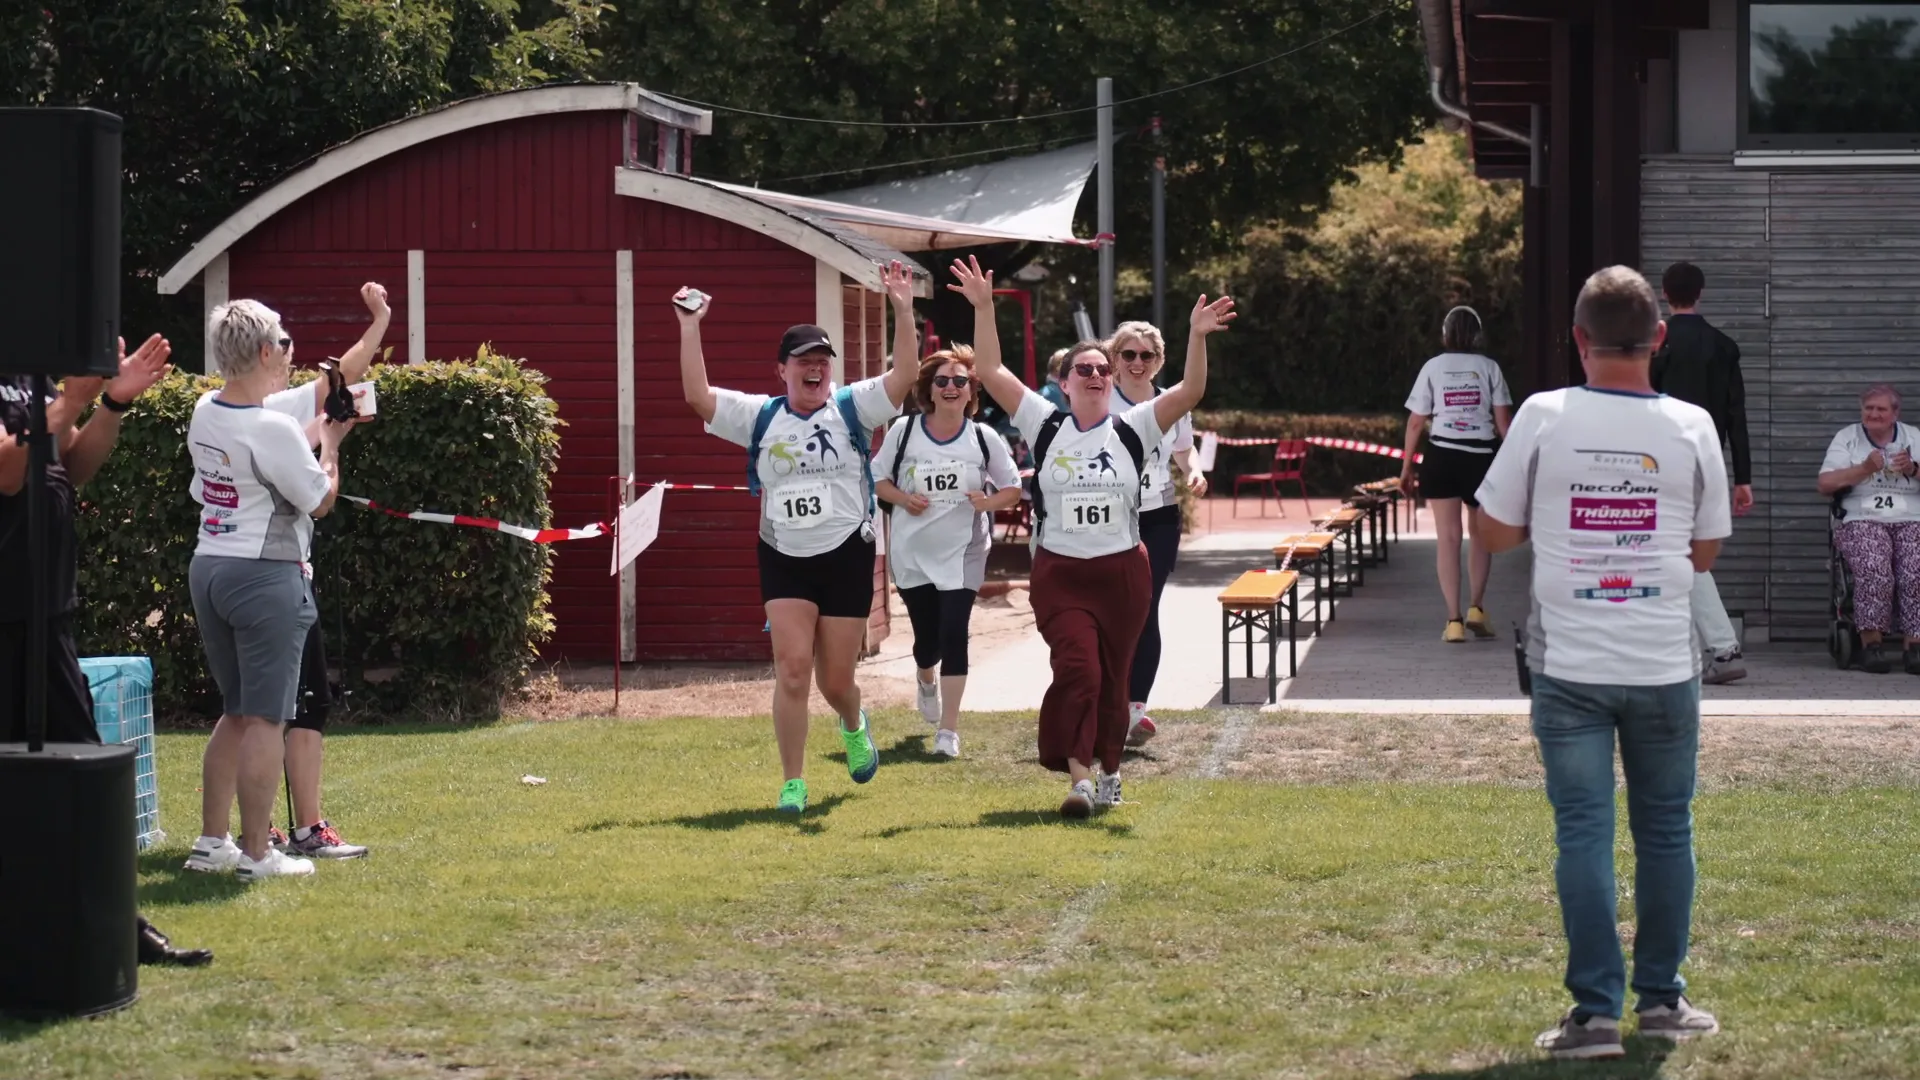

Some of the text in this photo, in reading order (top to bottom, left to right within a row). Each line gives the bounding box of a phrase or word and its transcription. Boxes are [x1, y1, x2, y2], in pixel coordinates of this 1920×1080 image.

[796, 464, 846, 476] LEBENS-LAUF
[924, 473, 959, 492] 162
[783, 496, 822, 518] 163
[1874, 496, 1894, 509] 24
[1073, 504, 1110, 525] 161
[1574, 505, 1656, 519] THÜRAUF
